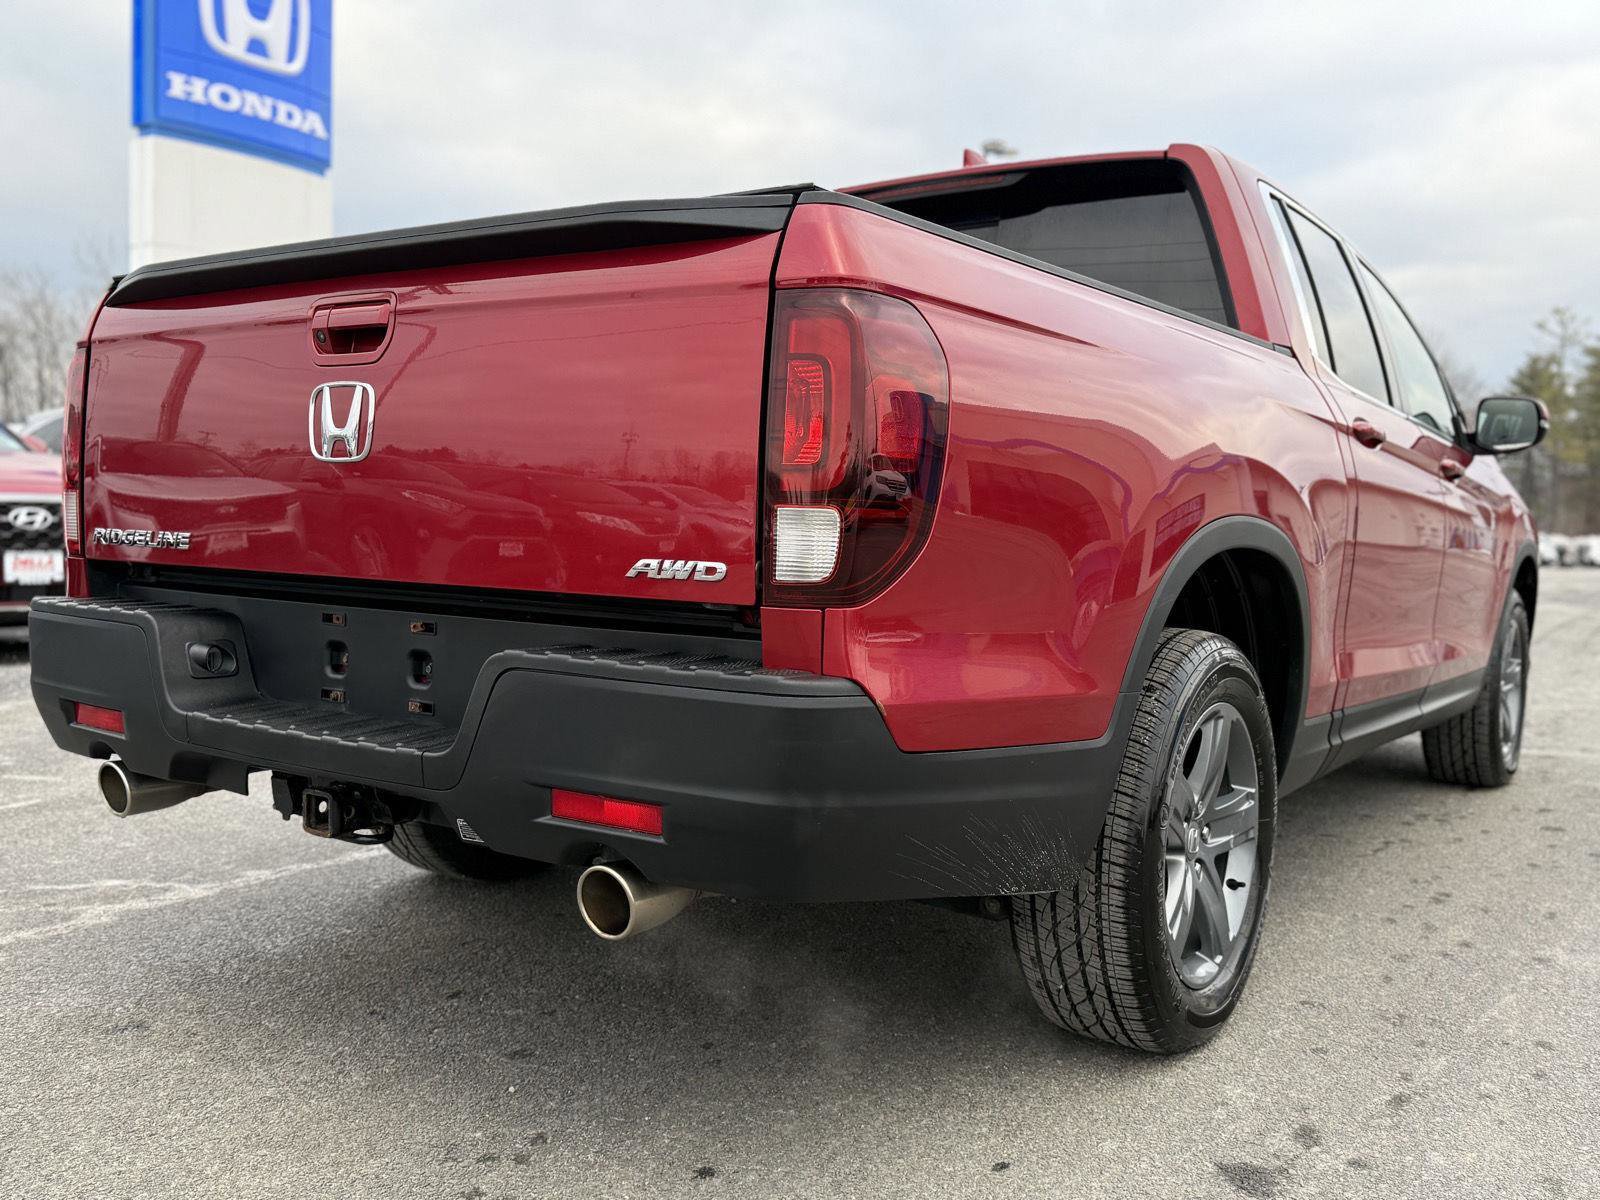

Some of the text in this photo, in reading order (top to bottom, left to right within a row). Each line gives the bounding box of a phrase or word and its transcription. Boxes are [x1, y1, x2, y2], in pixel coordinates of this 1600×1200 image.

[165, 70, 329, 140] HONDA
[93, 527, 192, 550] RIDGELINE
[624, 558, 728, 582] AWD
